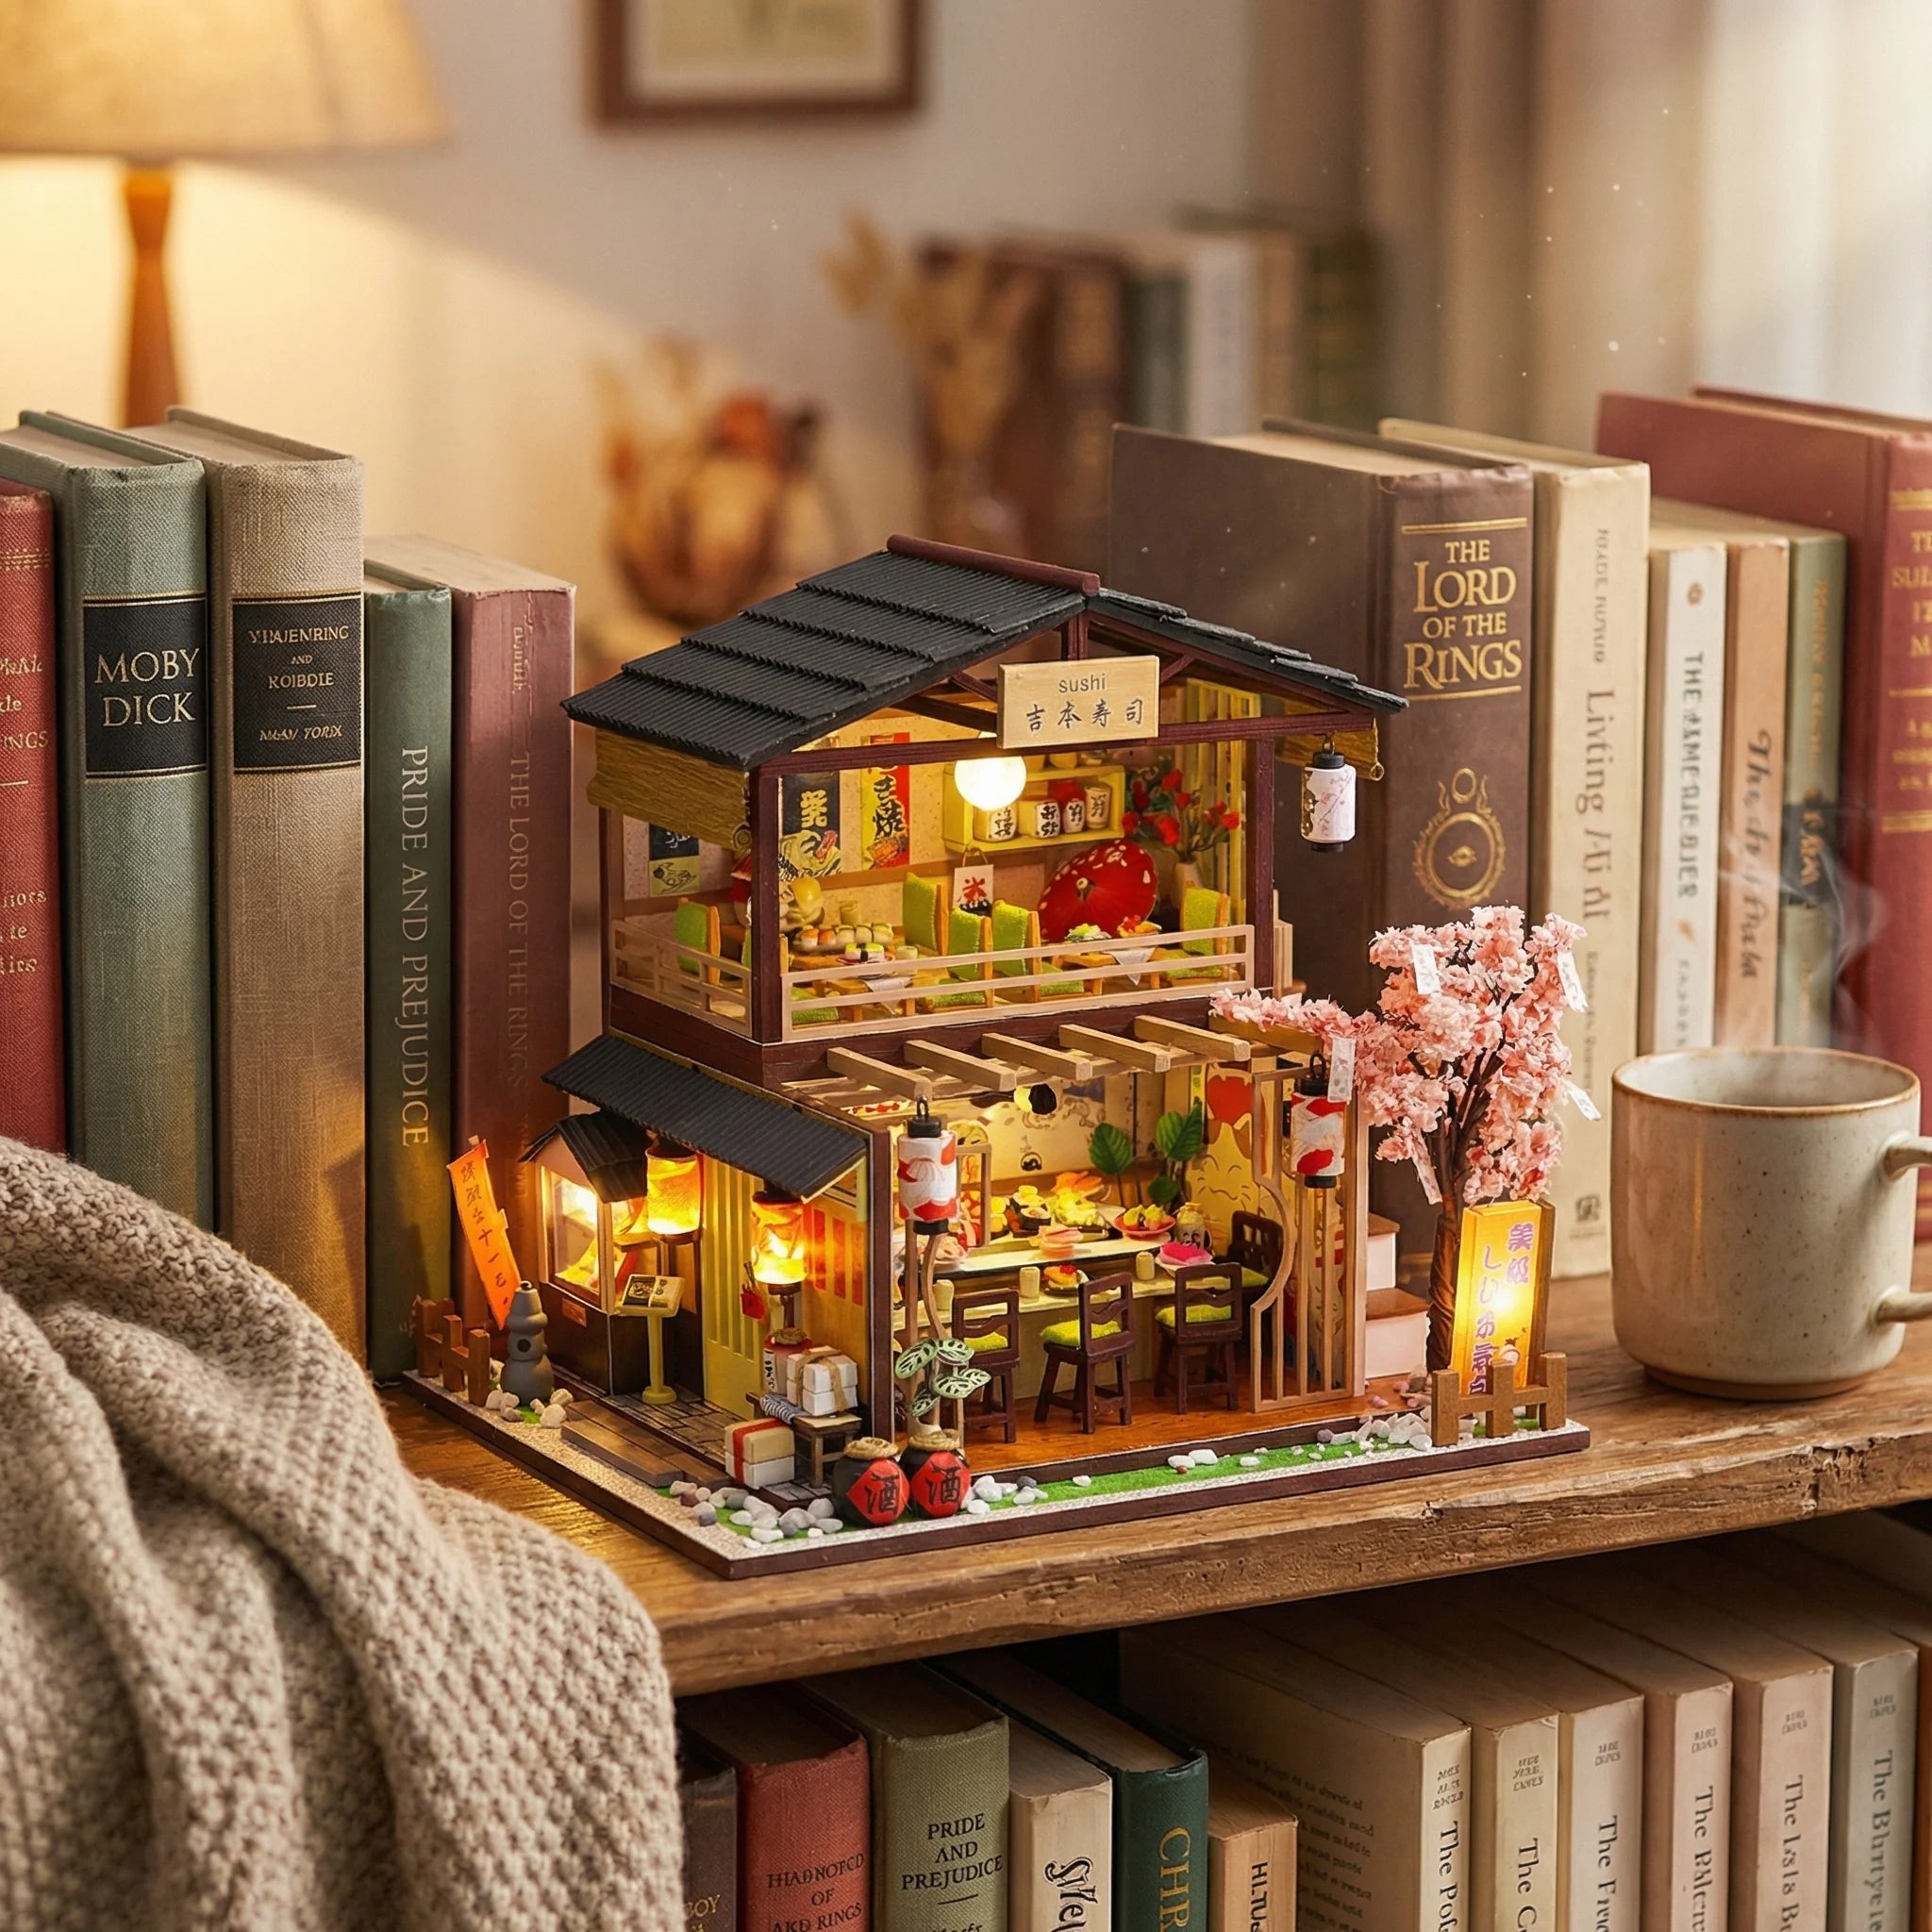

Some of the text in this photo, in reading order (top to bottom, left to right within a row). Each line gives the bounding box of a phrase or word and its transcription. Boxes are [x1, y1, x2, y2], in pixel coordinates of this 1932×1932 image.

[1444, 539, 1491, 563] THE
[1413, 560, 1517, 612] LORD
[1423, 611, 1507, 639] OF THE
[94, 647, 200, 684] MOBY
[291, 654, 314, 665] AND
[1403, 639, 1523, 690] RINGS
[1058, 673, 1107, 693] sushi
[102, 691, 196, 727] DICK
[1025, 698, 1144, 733] 吉本寿司
[510, 752, 530, 808] THE
[509, 817, 530, 891] LORD
[508, 900, 528, 934] OF
[394, 745, 429, 1147] PRIDE AND PREJUDICE
[508, 941, 528, 996] THE
[864, 1473, 901, 1514] 酒
[925, 1460, 961, 1506] 酒
[1873, 1750, 1893, 1803] The
[1693, 1786, 1714, 1838] The
[1784, 1774, 1804, 1825] The
[927, 1813, 986, 1840] PRIDE
[1598, 1814, 1618, 1869] The
[935, 1841, 979, 1864] AND
[1439, 1820, 1460, 1876] The
[901, 1855, 1004, 1890] PREJUDICE
[1517, 1838, 1540, 1932] The C
[811, 1888, 836, 1907] OF
[817, 1902, 862, 1930] RINGS
